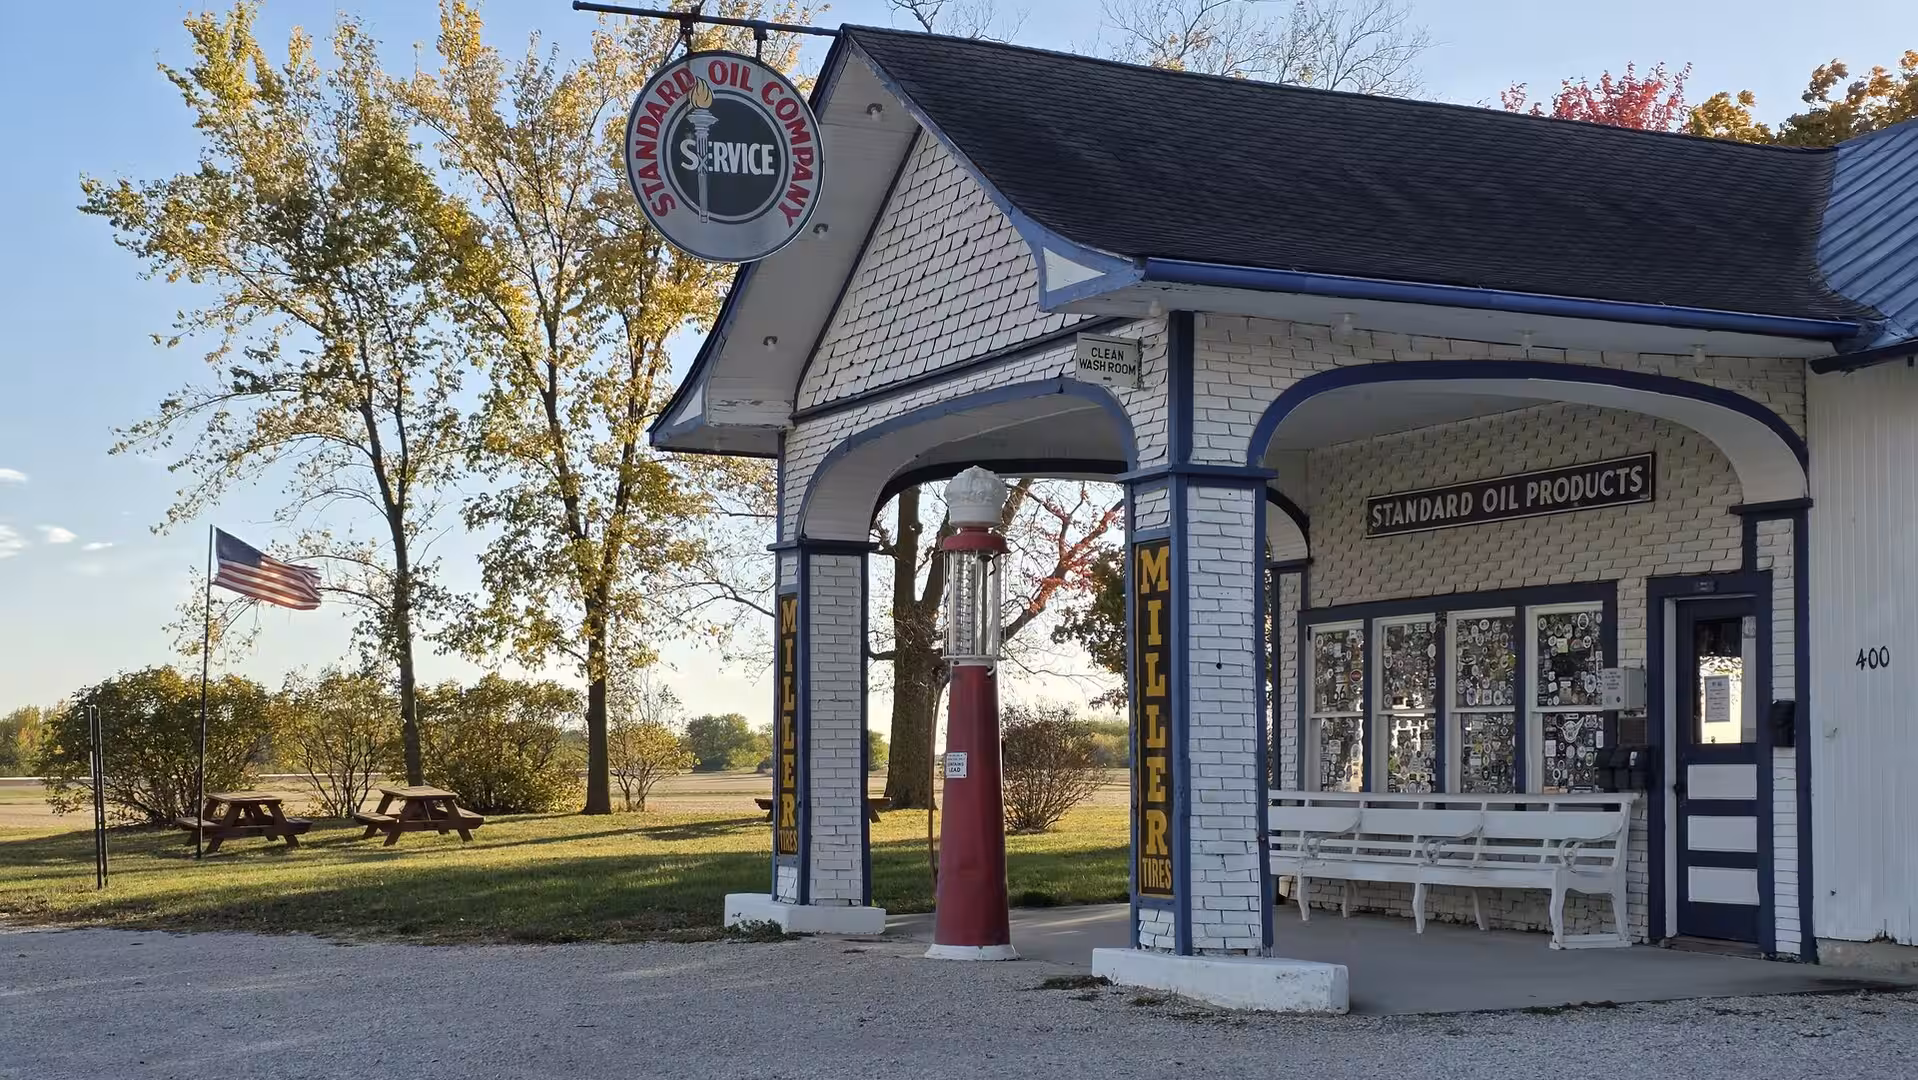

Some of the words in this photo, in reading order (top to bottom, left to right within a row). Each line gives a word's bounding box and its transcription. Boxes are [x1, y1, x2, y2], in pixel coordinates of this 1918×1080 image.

[635, 67, 696, 217] STANDARD
[708, 60, 753, 92] OIL
[761, 81, 814, 228] COMPANY
[1079, 358, 1106, 372] WASH
[1107, 363, 1136, 375] ROOM
[1091, 347, 1124, 361] CLEAN
[1372, 493, 1473, 528] STANDARD
[1482, 485, 1518, 513] OIL
[1527, 465, 1643, 507] PRODUCTS
[1855, 645, 1890, 671] 400
[781, 599, 798, 827] MILLER
[1140, 545, 1169, 855] MILLER
[779, 829, 798, 852] TIRES
[1142, 857, 1172, 890] TIRES
